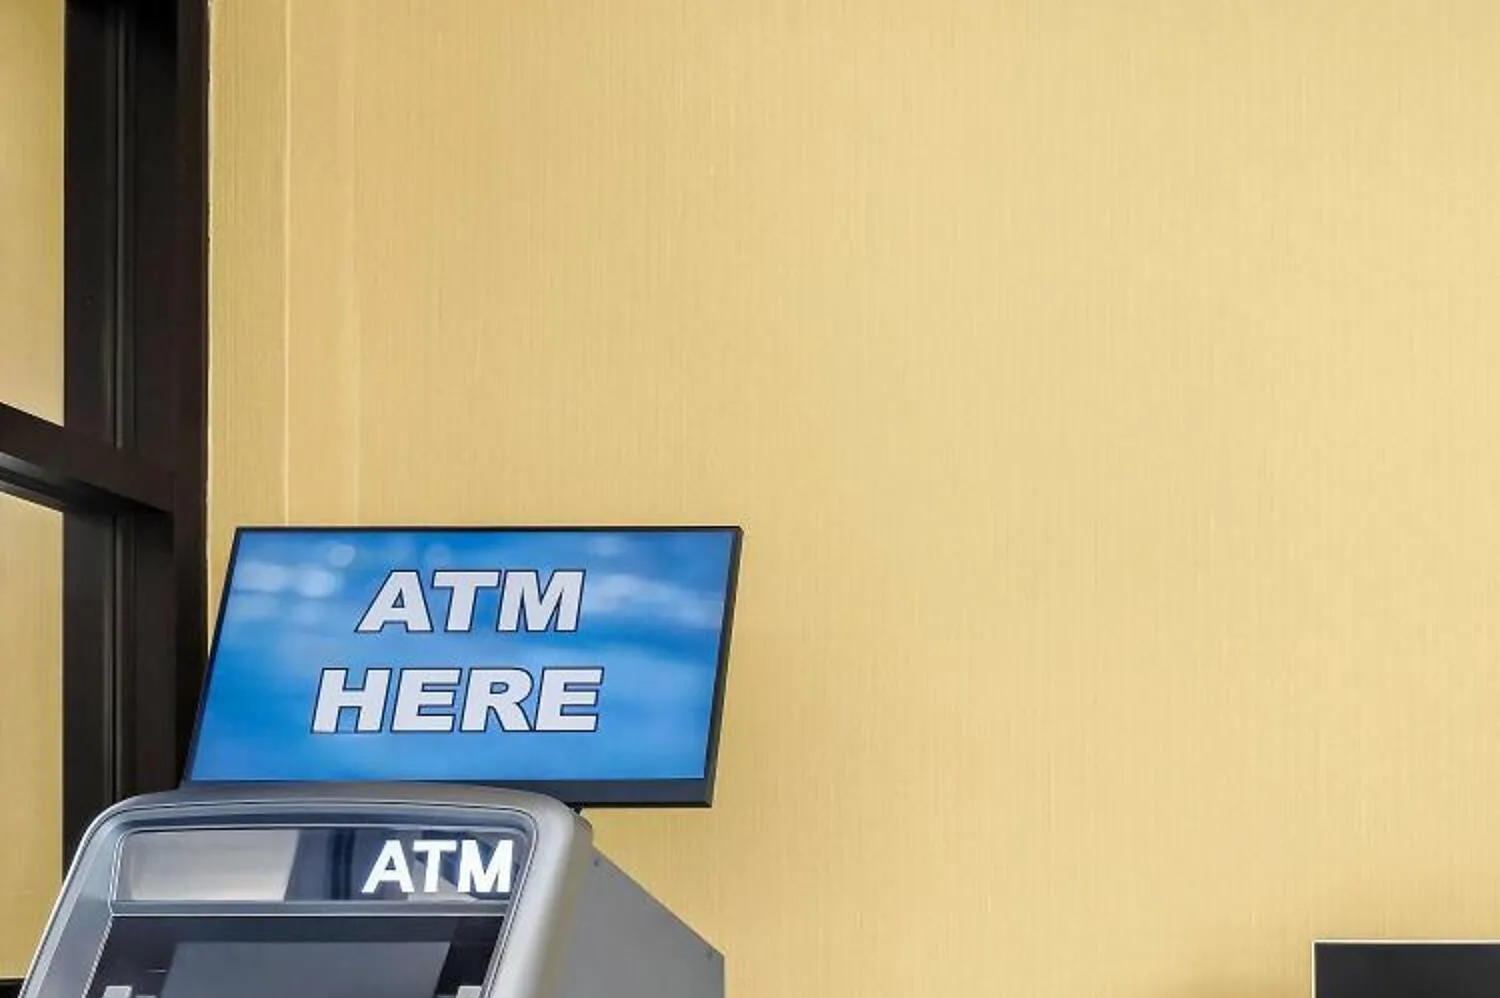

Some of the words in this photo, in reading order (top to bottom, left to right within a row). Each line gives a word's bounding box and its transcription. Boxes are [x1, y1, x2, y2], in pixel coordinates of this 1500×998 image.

[354, 569, 586, 632] ATM
[311, 667, 604, 734] HERE
[361, 839, 514, 893] ATM
